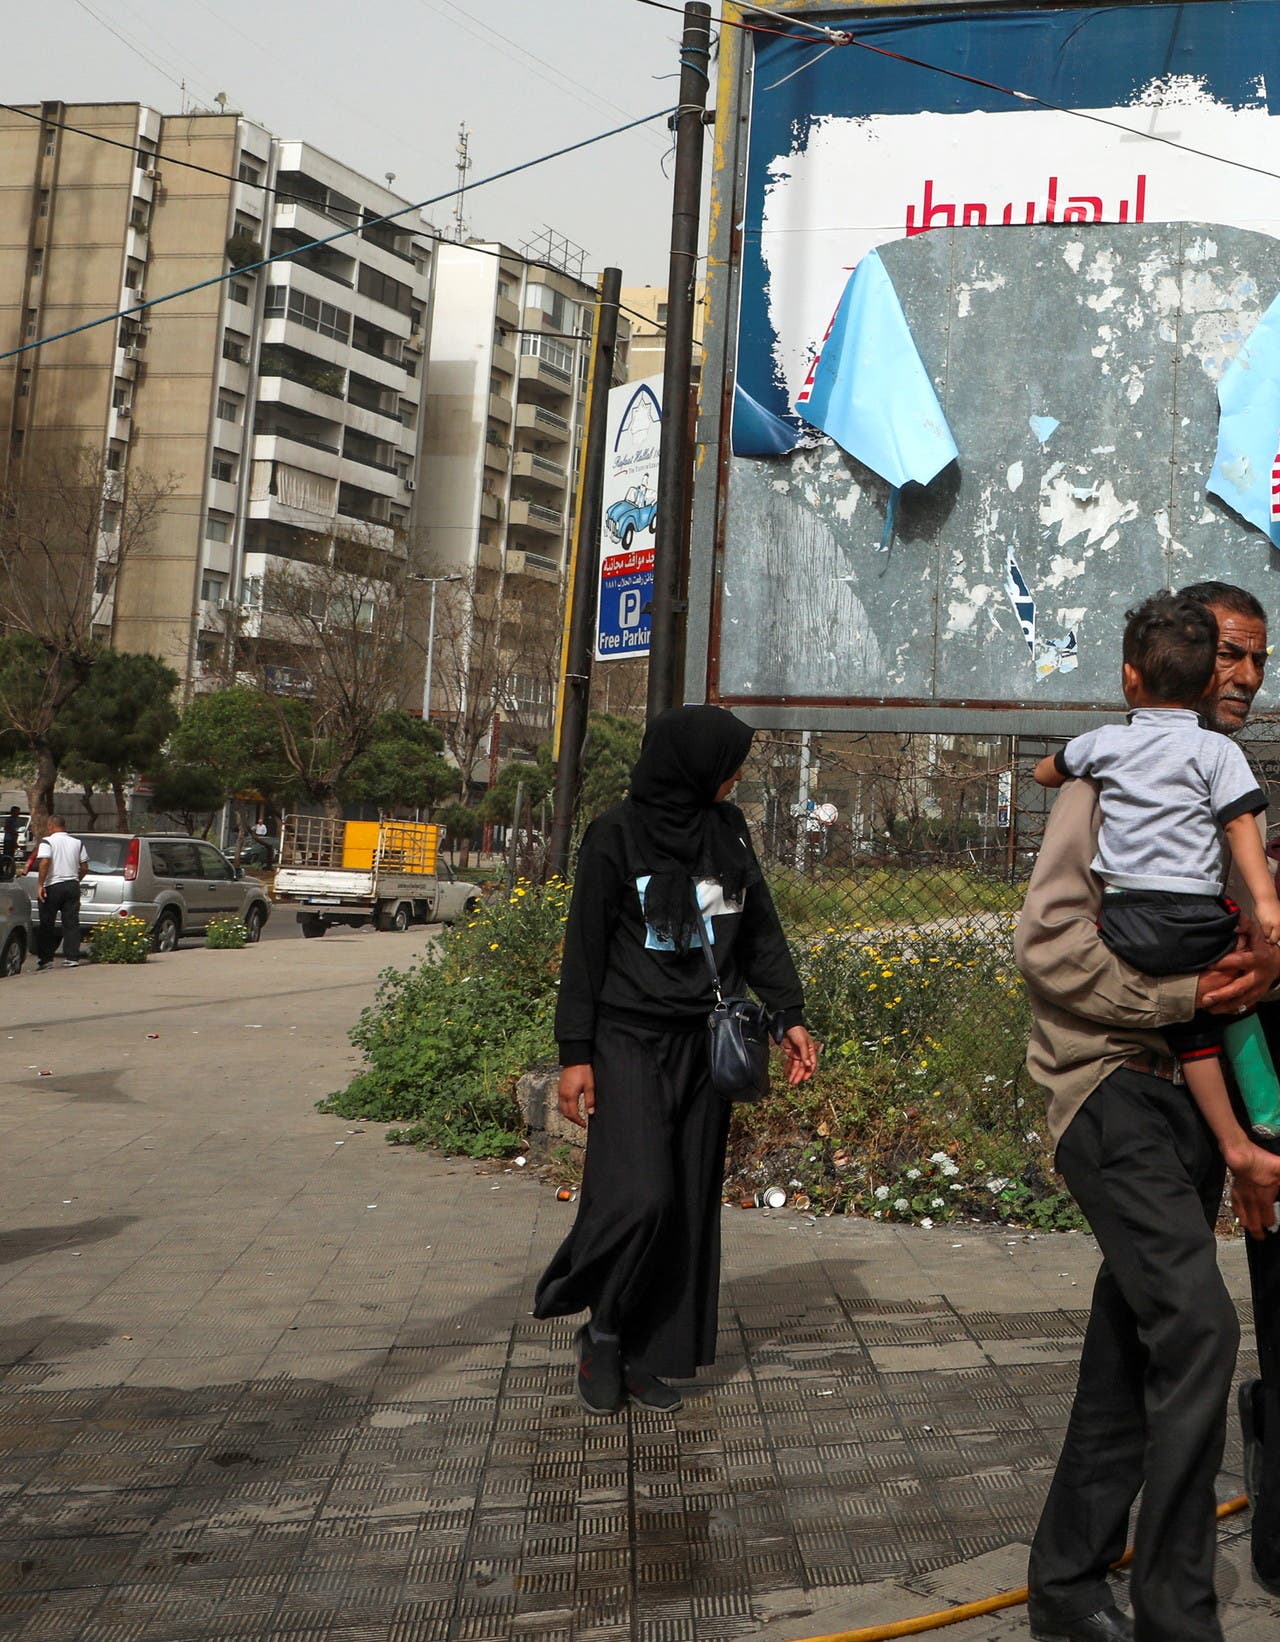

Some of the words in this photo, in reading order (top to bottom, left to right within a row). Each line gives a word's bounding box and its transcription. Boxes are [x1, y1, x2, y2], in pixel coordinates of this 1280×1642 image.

[603, 557, 624, 575] مجانية
[625, 552, 645, 570] مواقف
[600, 632, 620, 650] Free
[622, 627, 651, 647] Parkin
